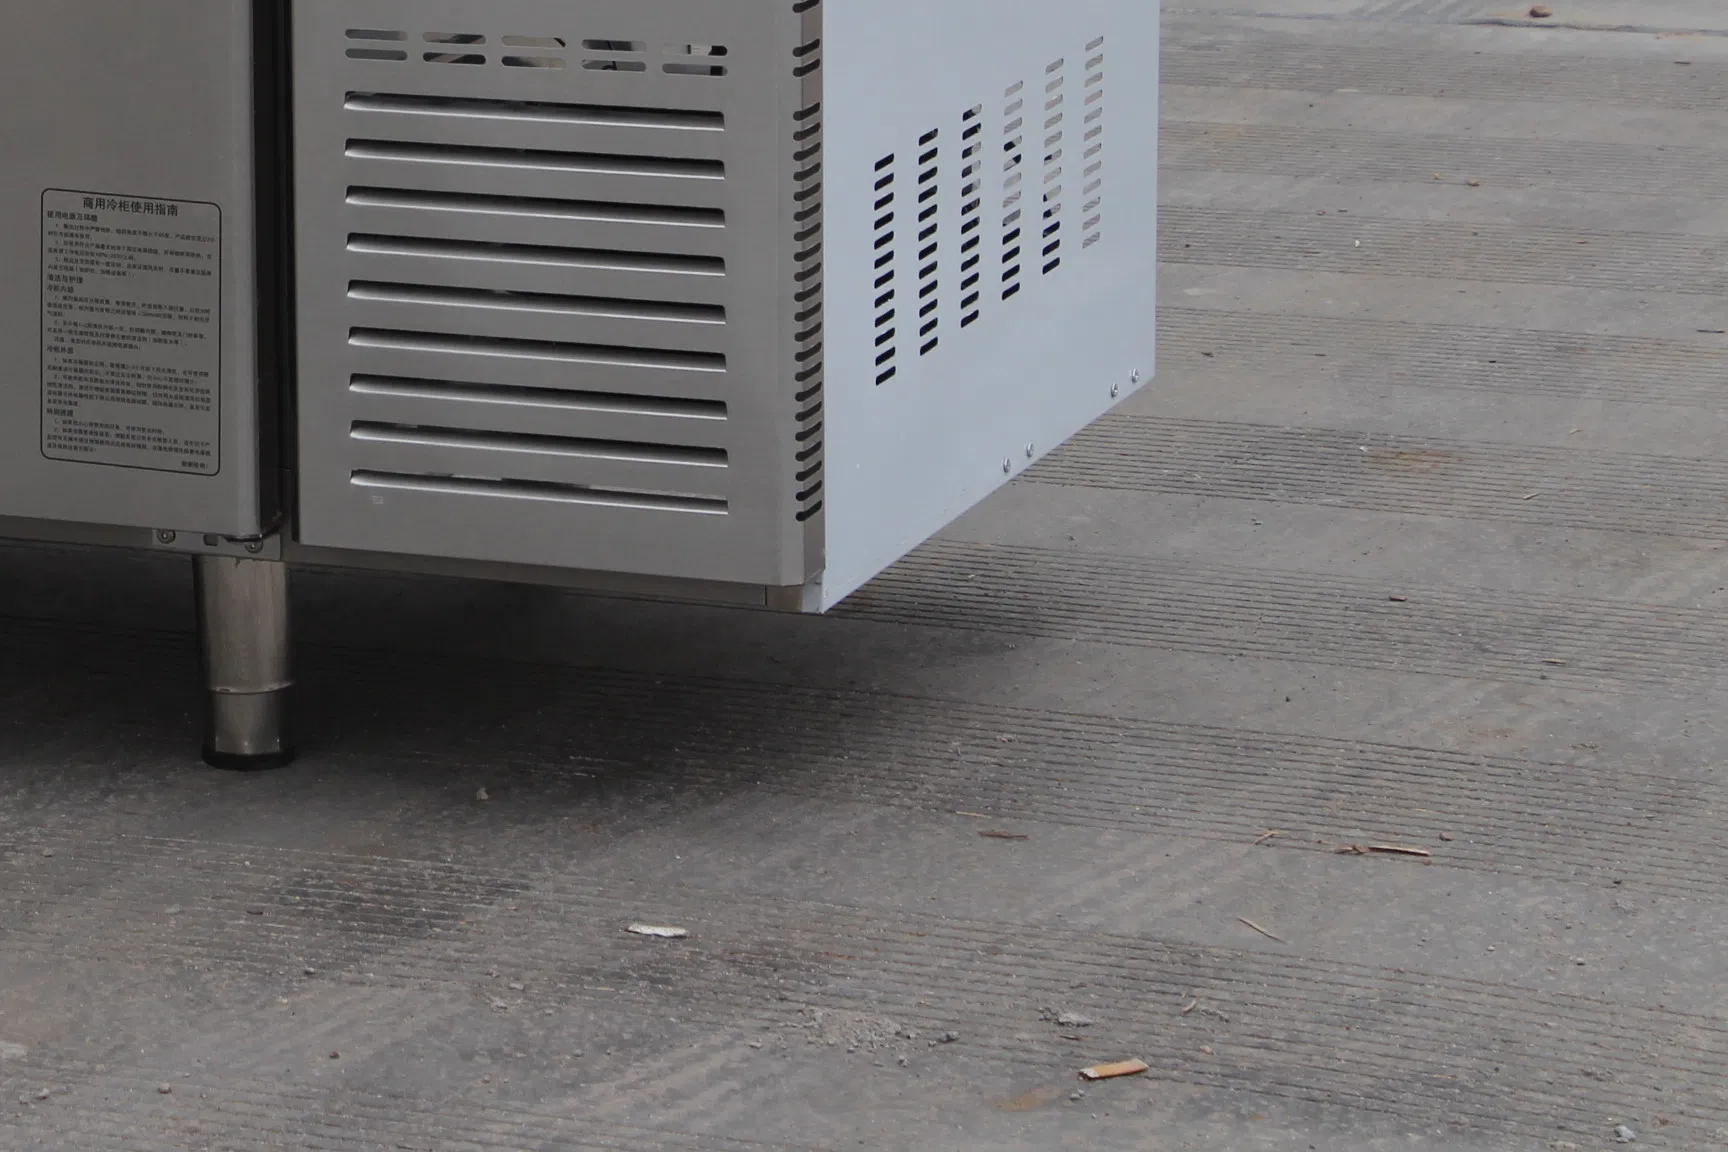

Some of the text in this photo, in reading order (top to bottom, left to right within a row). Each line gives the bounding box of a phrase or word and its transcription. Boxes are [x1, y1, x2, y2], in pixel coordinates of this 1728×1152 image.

[83, 197, 178, 217] 商用冷柜使用指南
